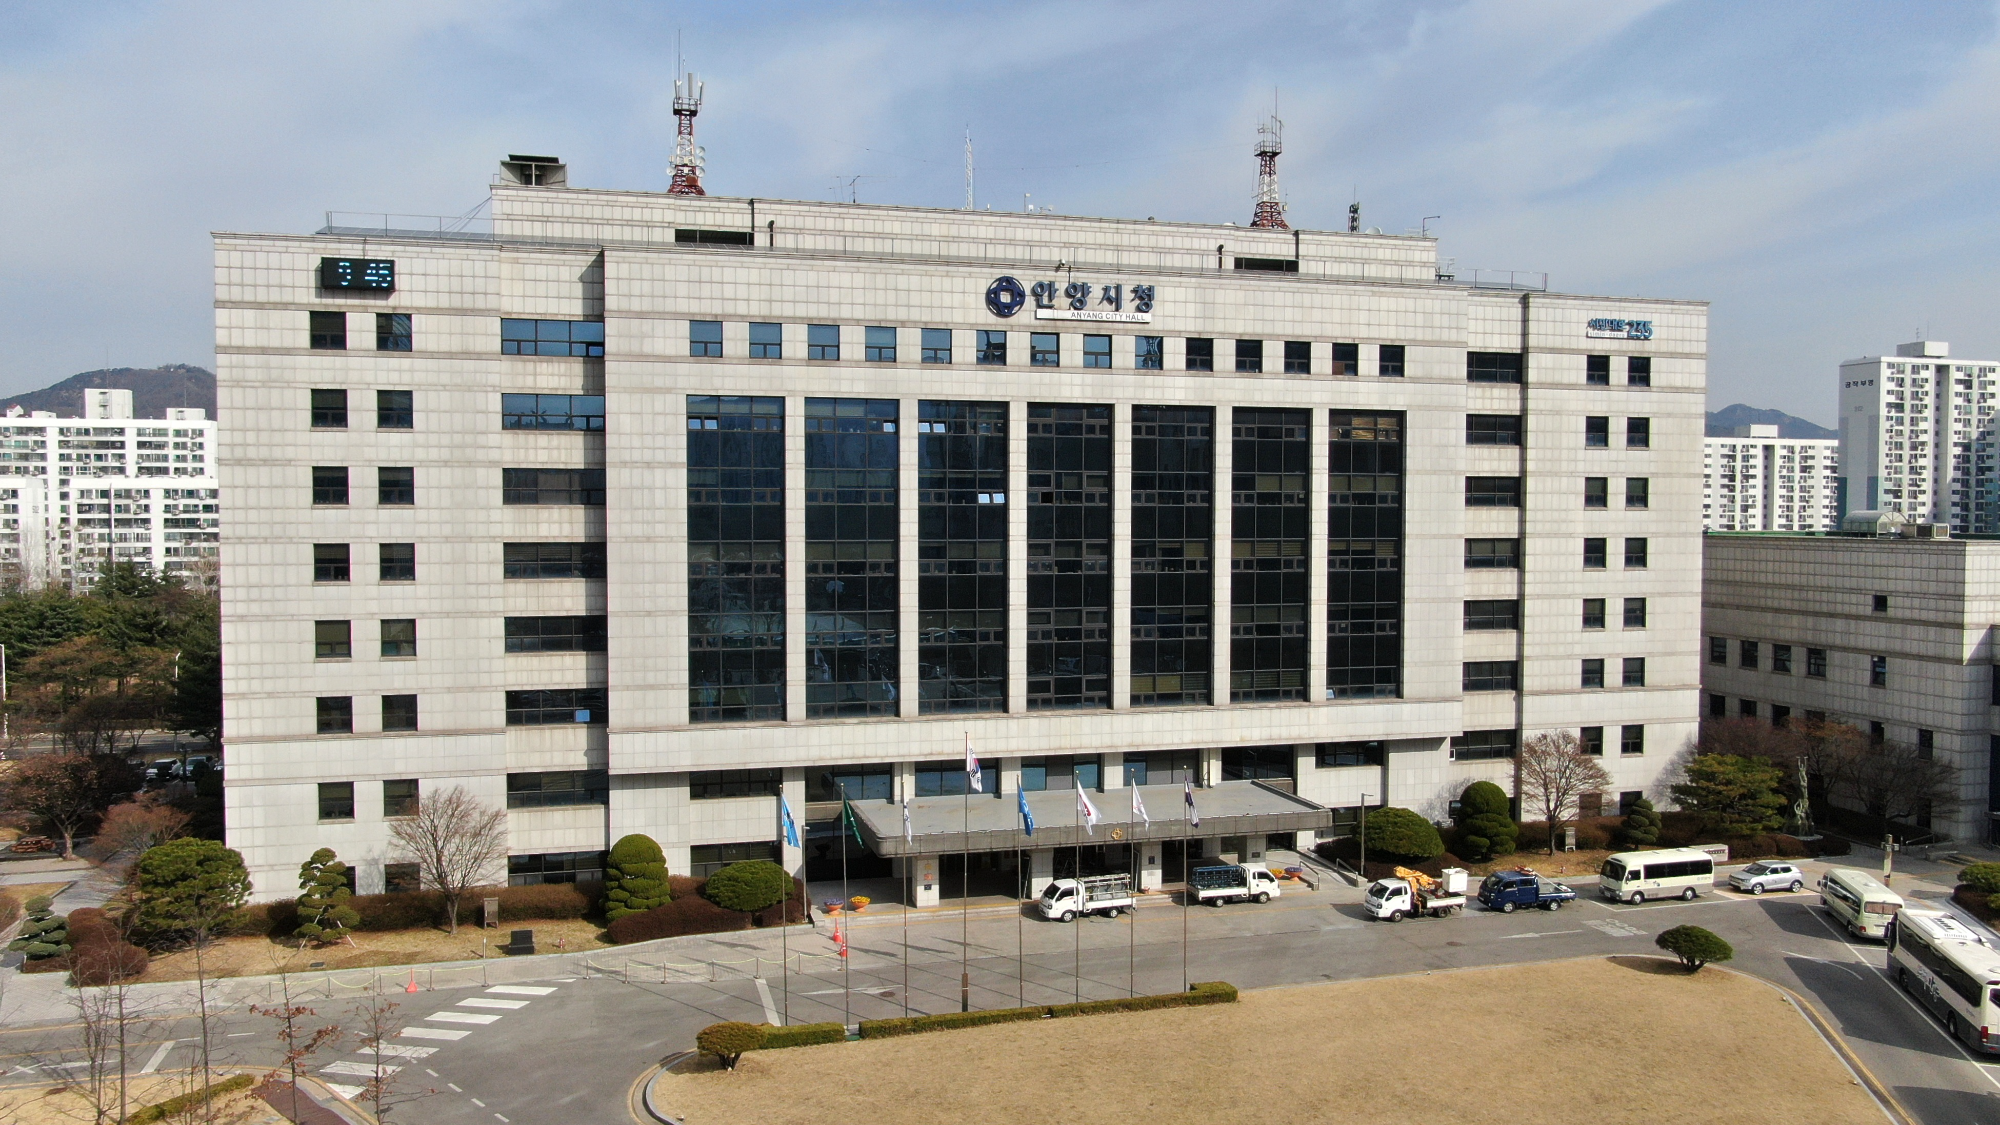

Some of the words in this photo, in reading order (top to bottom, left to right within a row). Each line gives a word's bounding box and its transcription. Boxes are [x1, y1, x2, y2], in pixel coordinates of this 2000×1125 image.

[1031, 280, 1156, 313] 안양시청
[1070, 311, 1103, 320] ANYANG
[1105, 313, 1124, 321] CITY
[1125, 313, 1146, 321] HALL
[1628, 320, 1654, 339] 235
